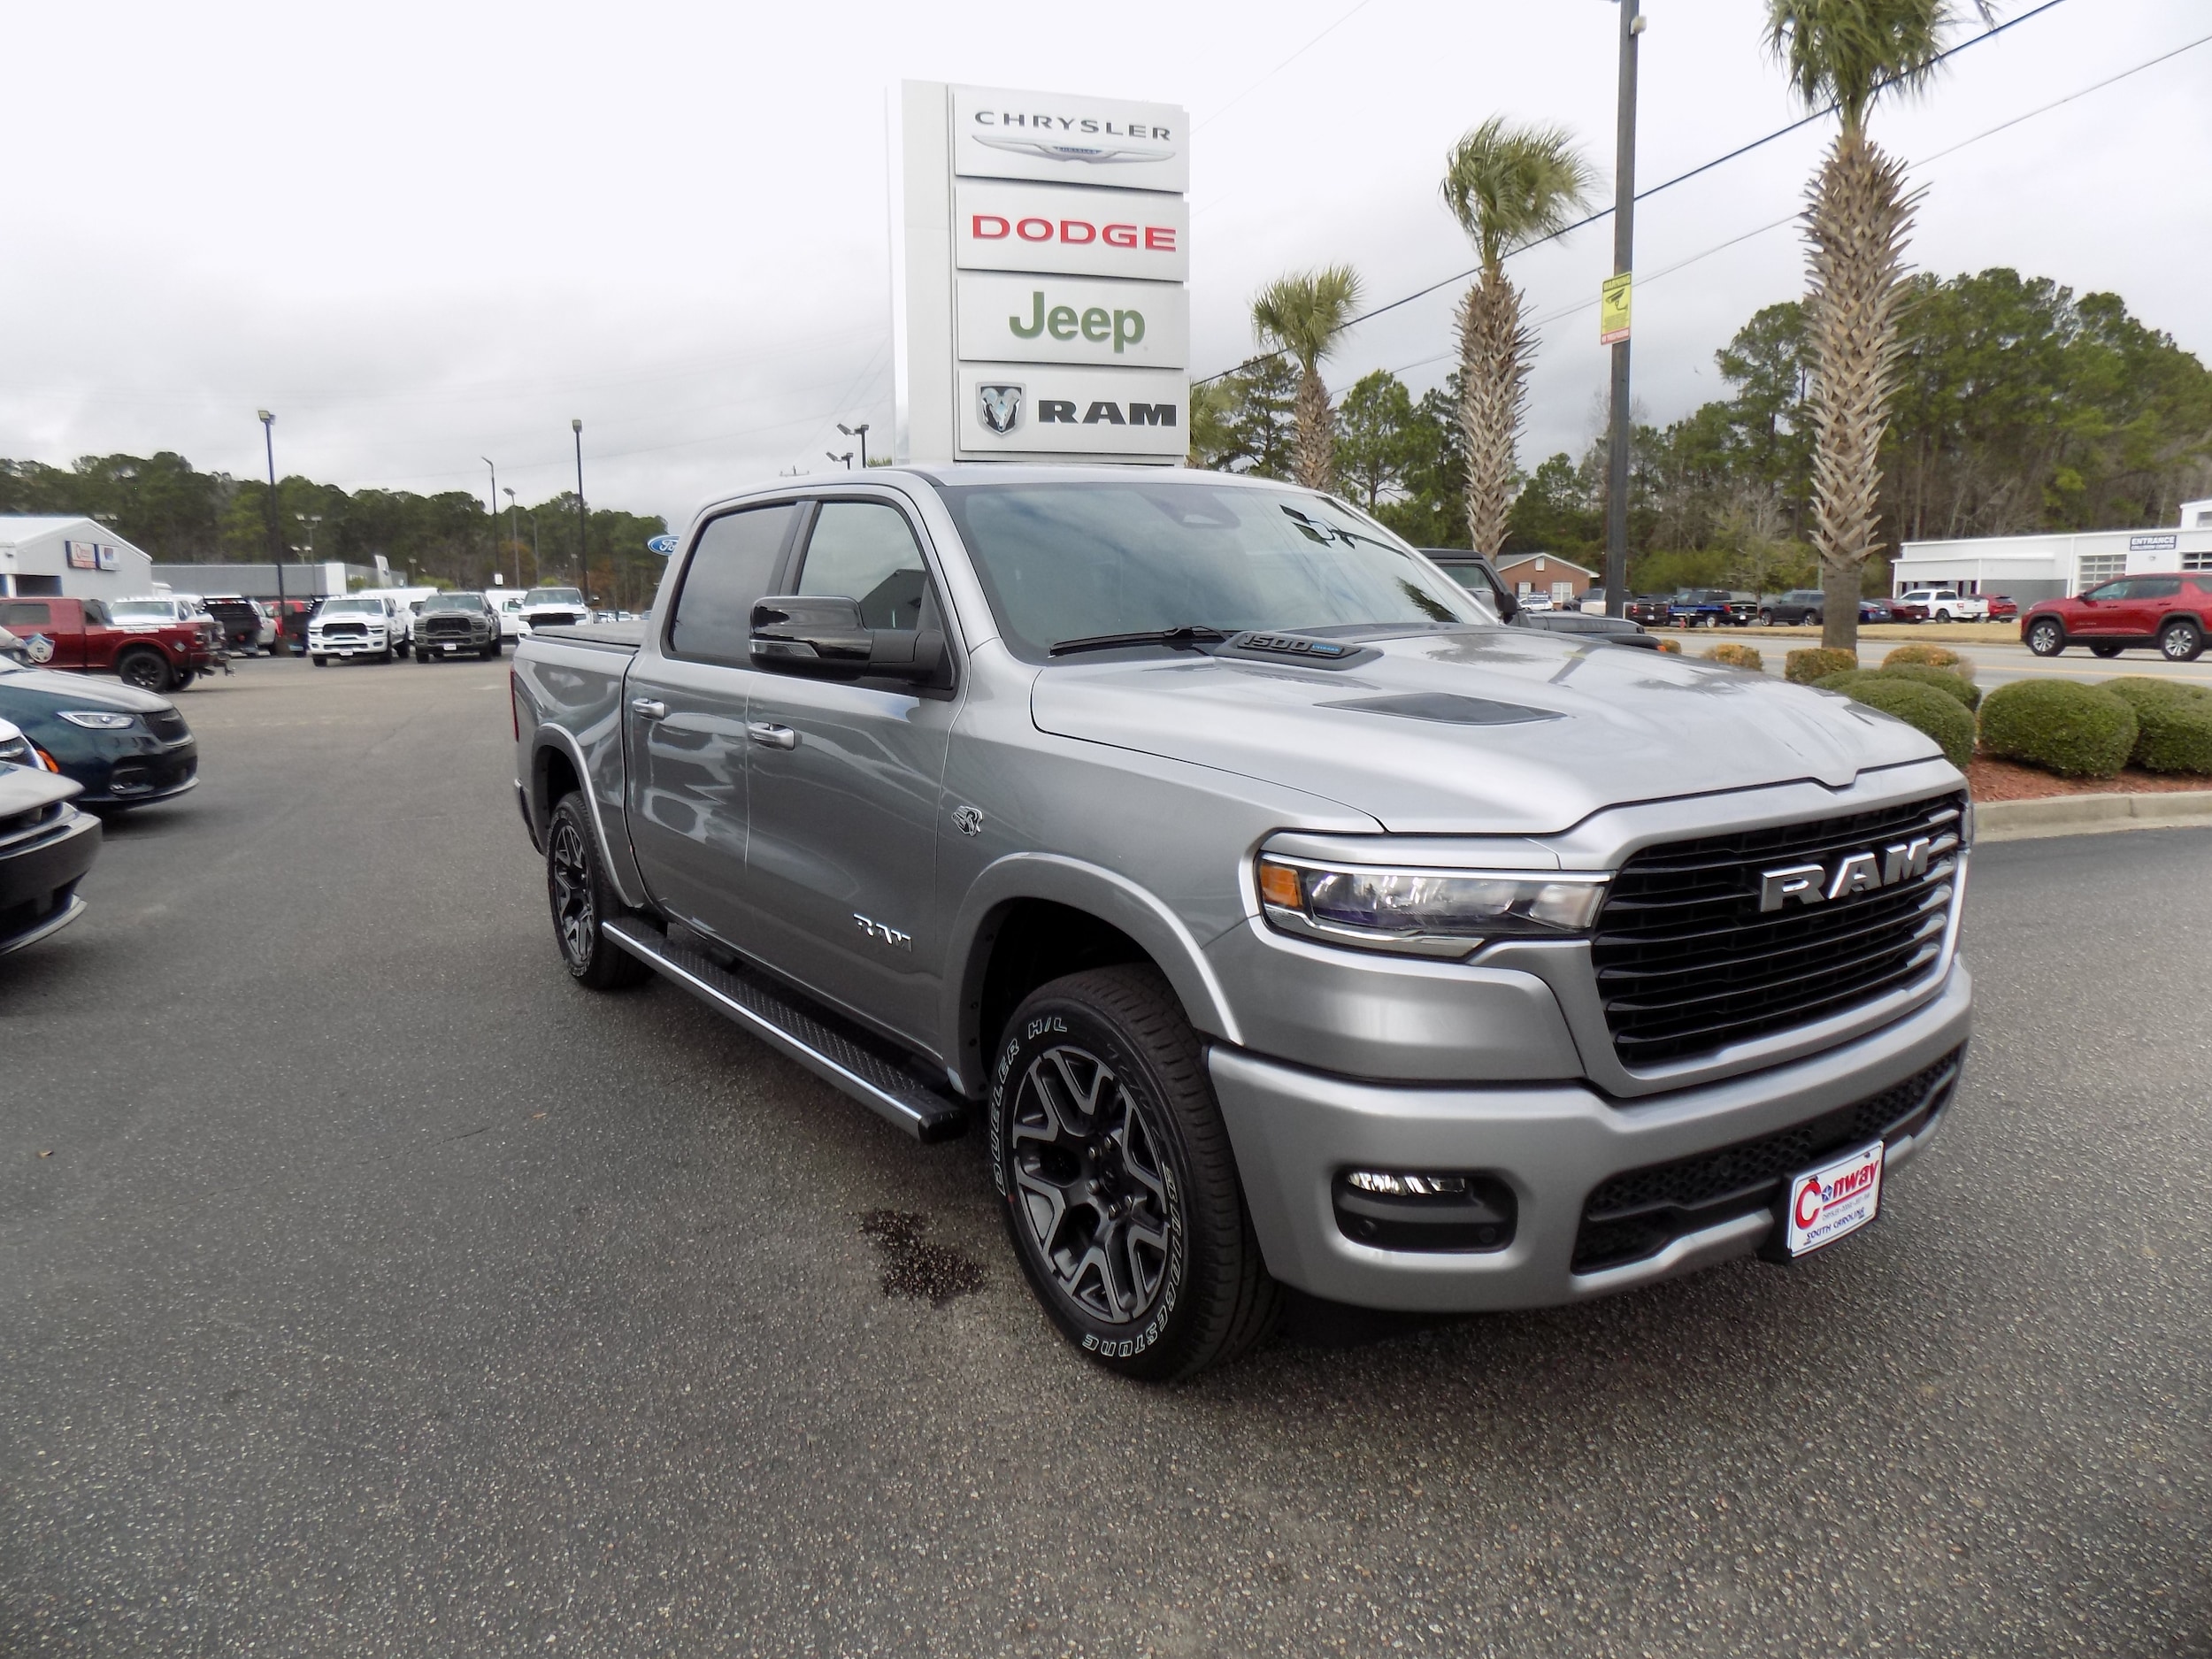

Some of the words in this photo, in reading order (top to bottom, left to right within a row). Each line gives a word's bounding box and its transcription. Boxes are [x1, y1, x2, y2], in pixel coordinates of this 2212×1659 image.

[974, 111, 1171, 141] CHRYSLER
[973, 214, 1176, 252] DODGE
[1009, 291, 1145, 353] Jeep
[1039, 400, 1176, 426] RAM
[2131, 536, 2176, 545] ENTRANCE
[1242, 634, 1310, 652] 1500
[1759, 836, 1931, 913] RAM
[853, 912, 913, 954] RAM
[987, 1038, 1020, 1197] DUELER
[1027, 1016, 1068, 1040] H/L
[1081, 1161, 1183, 1358] BRIDGESTONE
